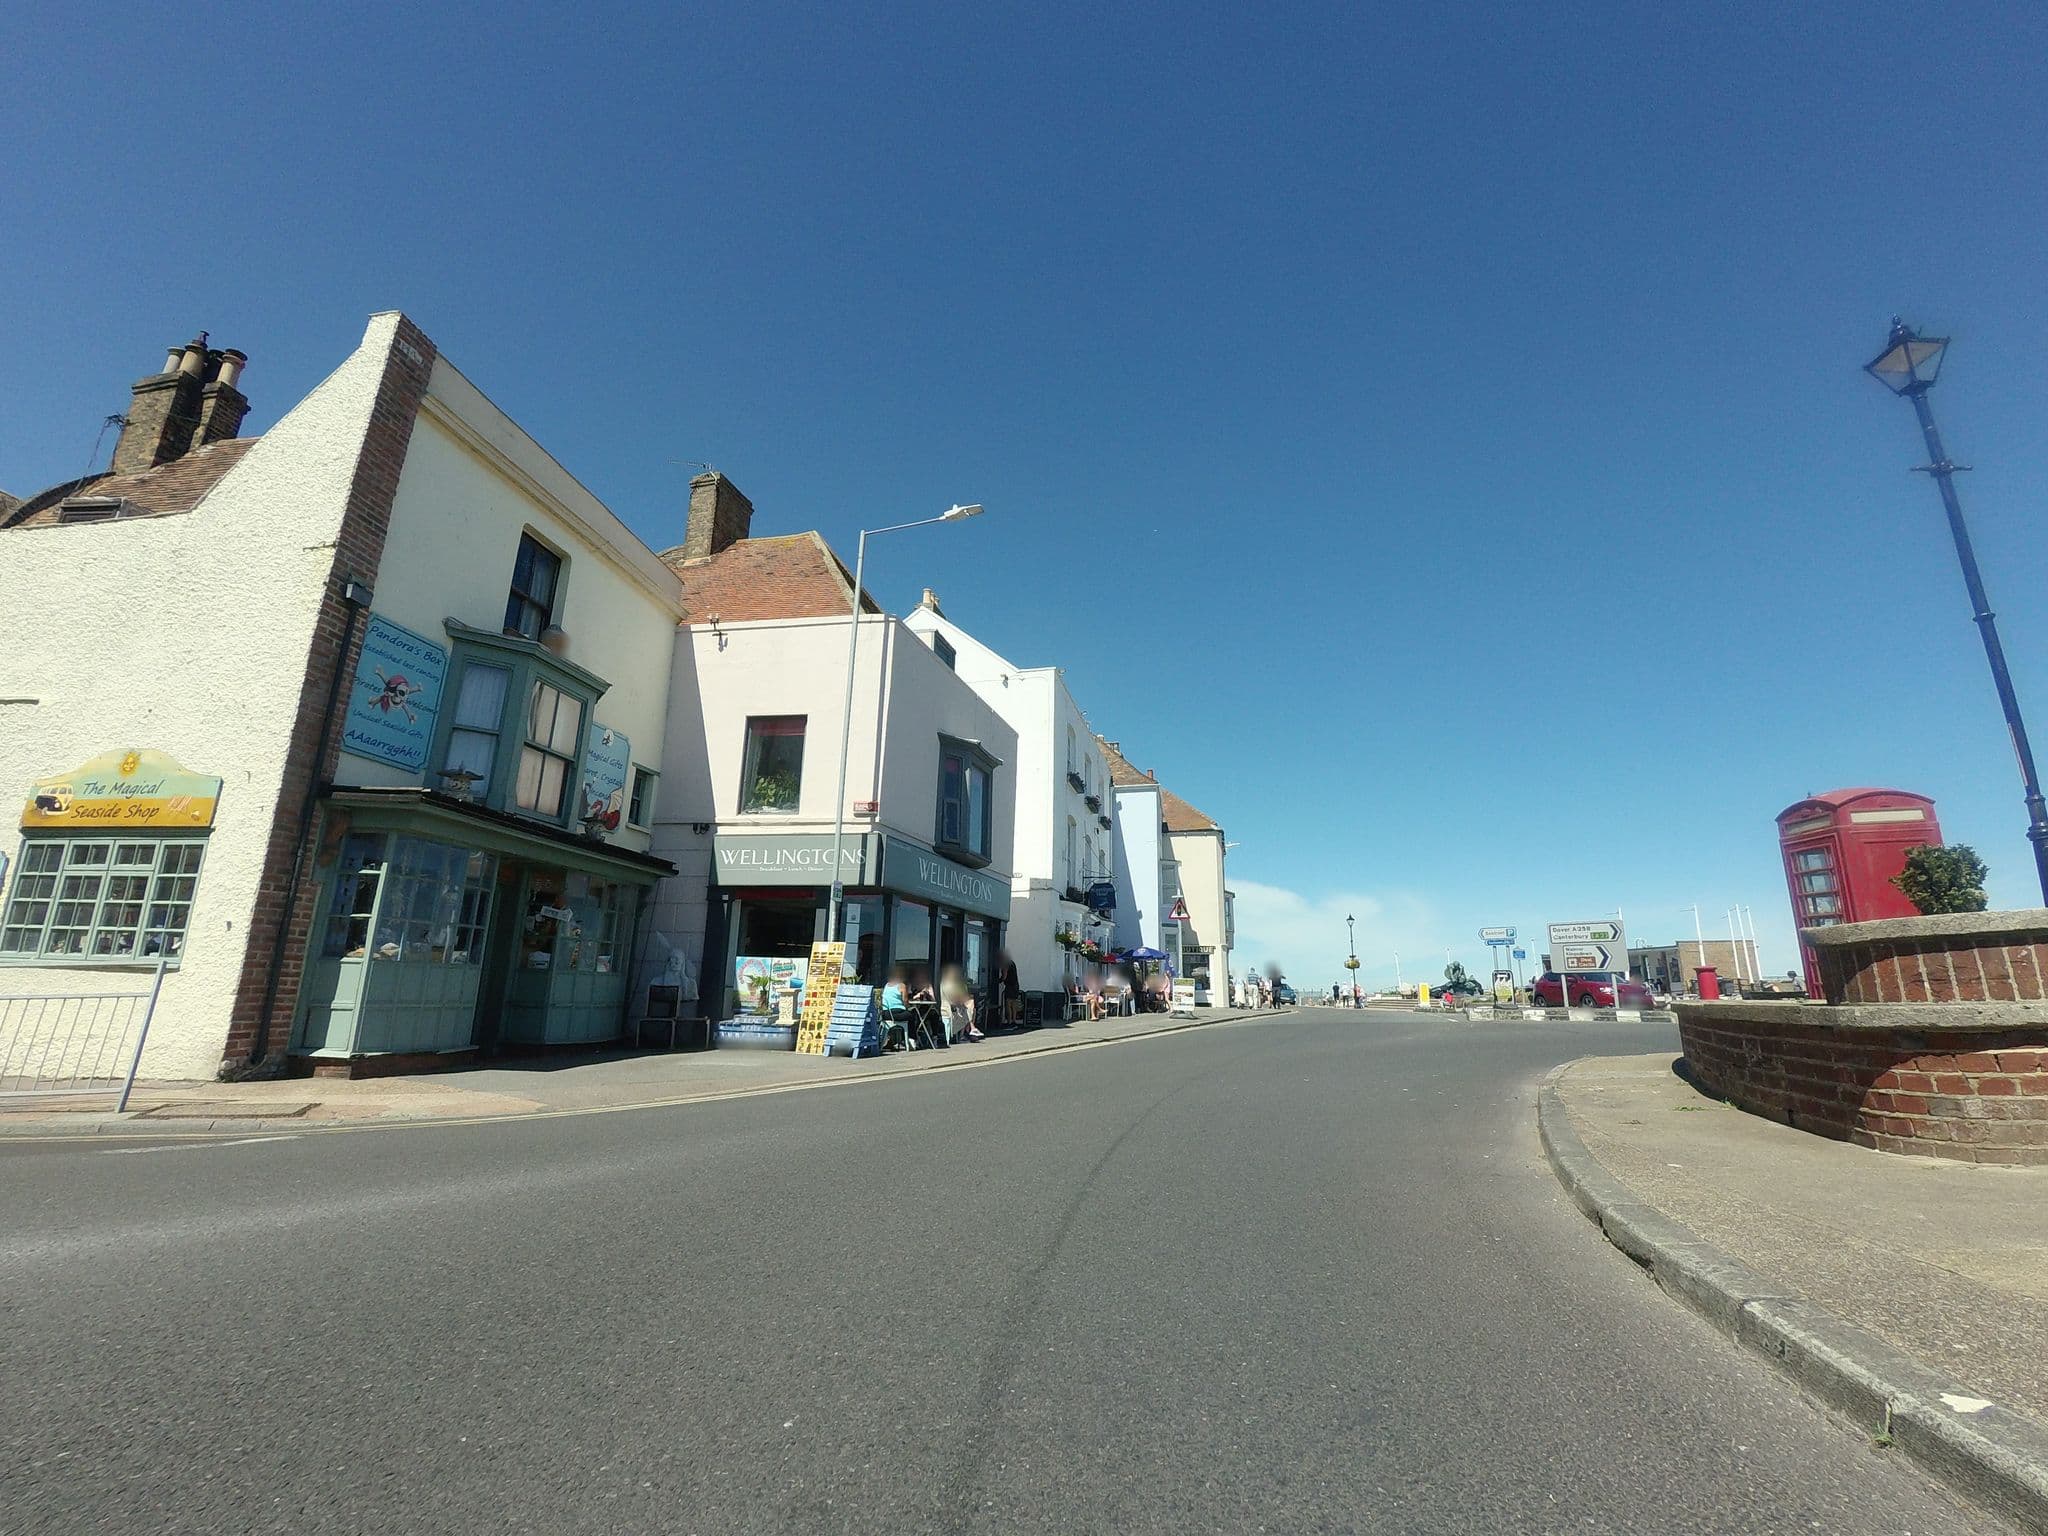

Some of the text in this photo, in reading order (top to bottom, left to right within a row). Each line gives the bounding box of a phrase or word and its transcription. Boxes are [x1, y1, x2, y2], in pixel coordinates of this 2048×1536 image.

[363, 643, 402, 664] Established
[370, 625, 442, 666] Pandora's Box
[82, 779, 165, 799] The Magical
[71, 803, 160, 824] Seaside Shop
[918, 856, 993, 903] WELLINGTONS
